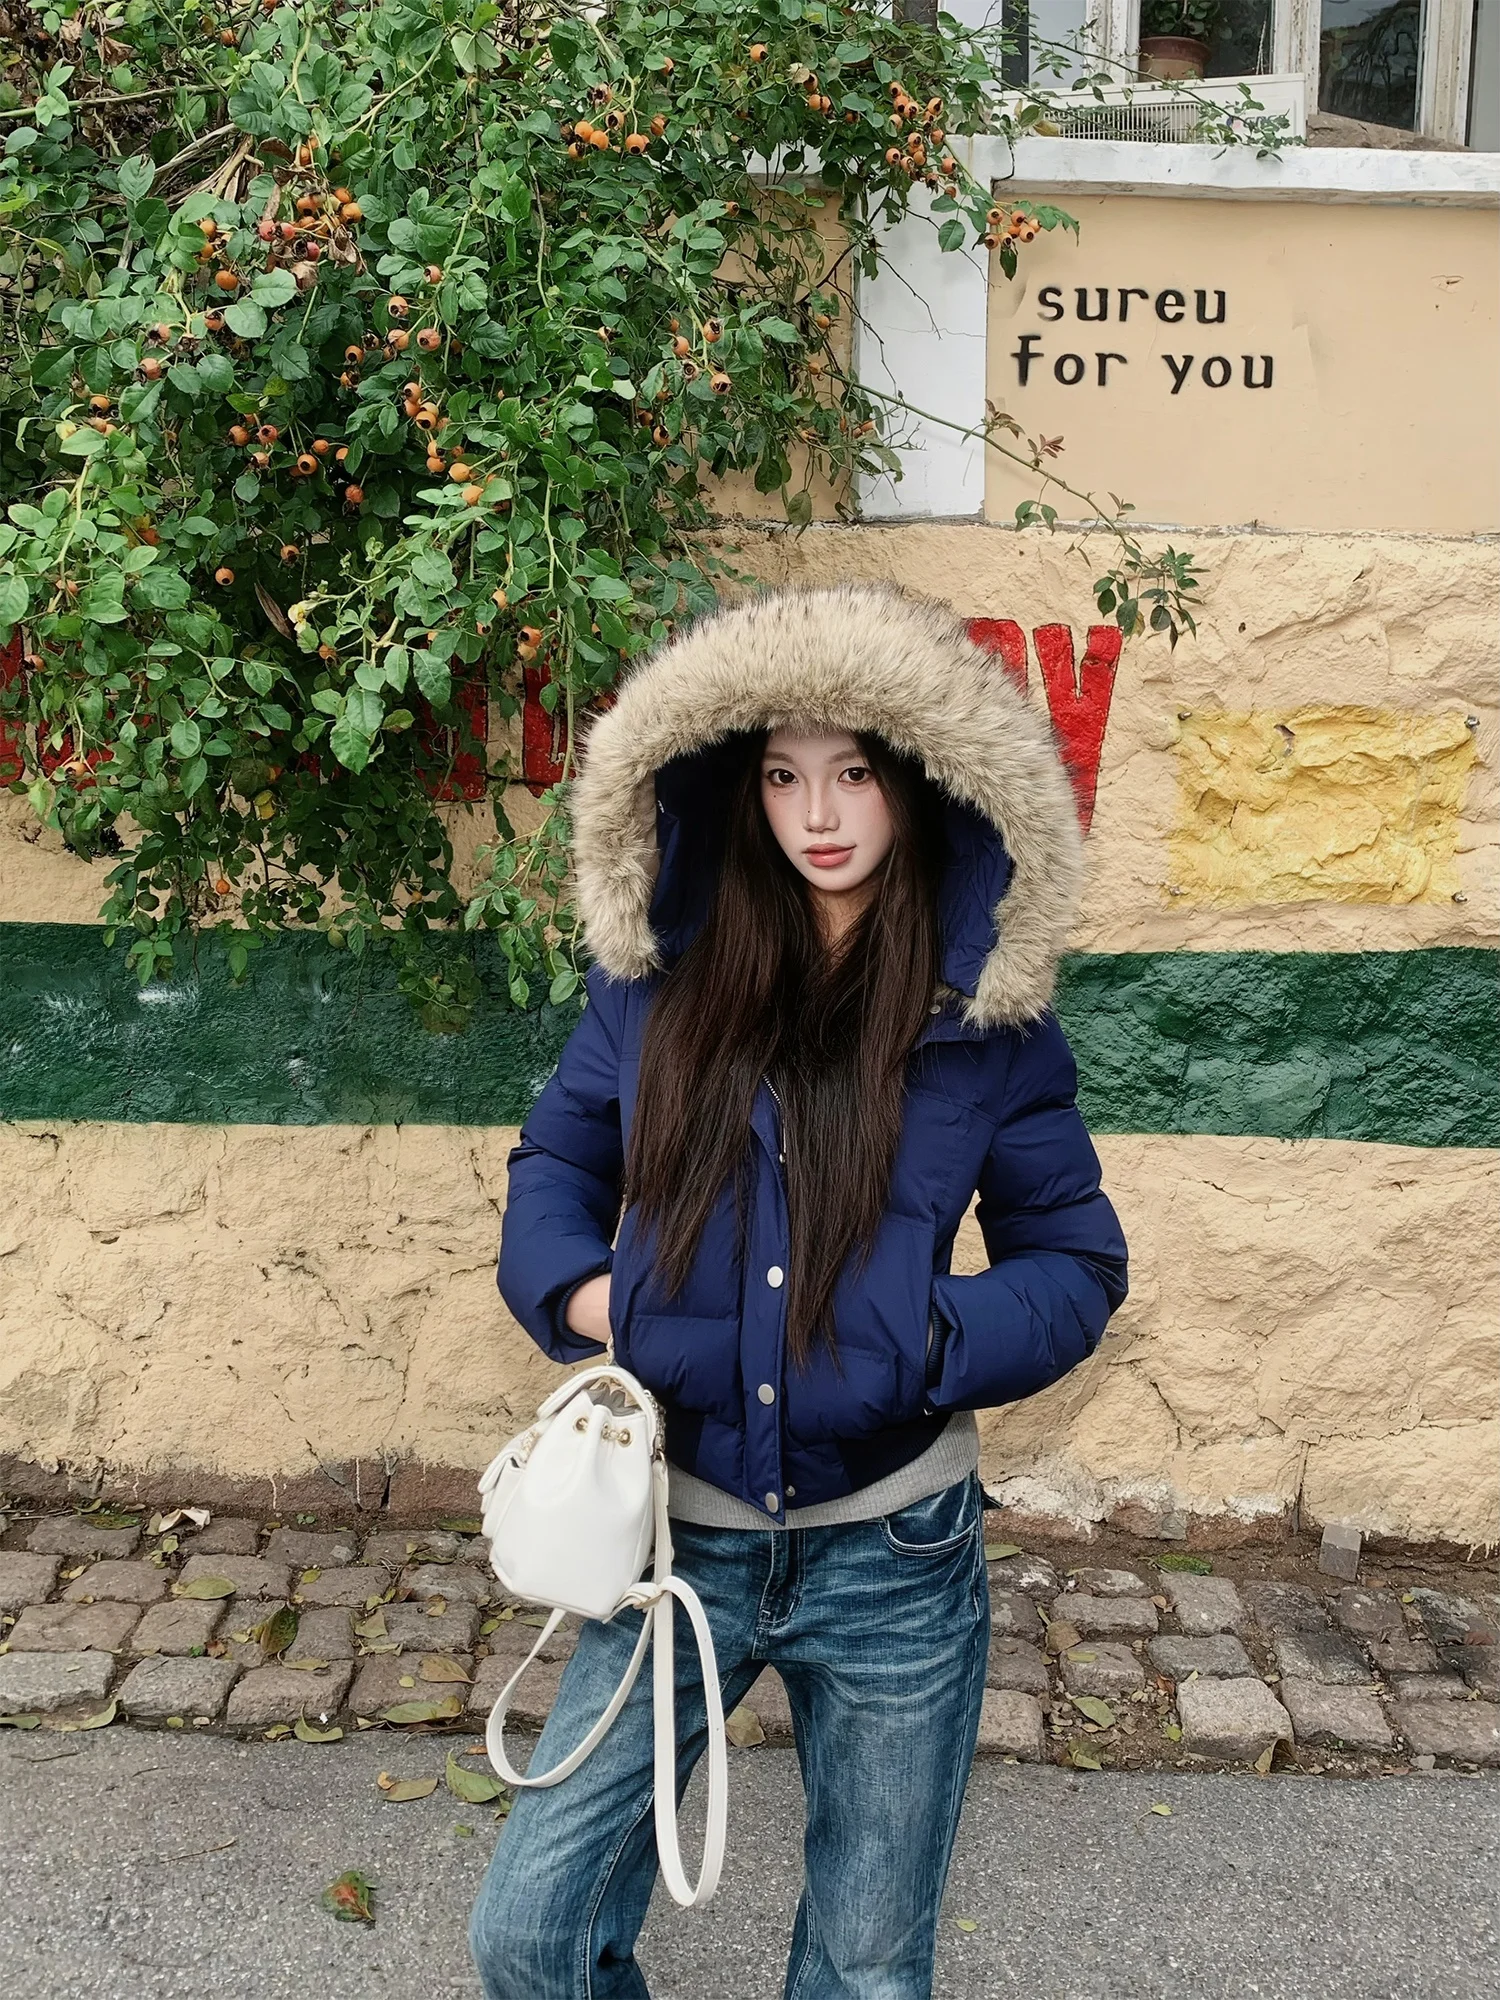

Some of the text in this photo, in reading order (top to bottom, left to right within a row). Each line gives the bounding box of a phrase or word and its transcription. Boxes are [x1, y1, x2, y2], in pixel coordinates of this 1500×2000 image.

[1037, 286, 1226, 324] sureu
[1010, 334, 1274, 395] for you
